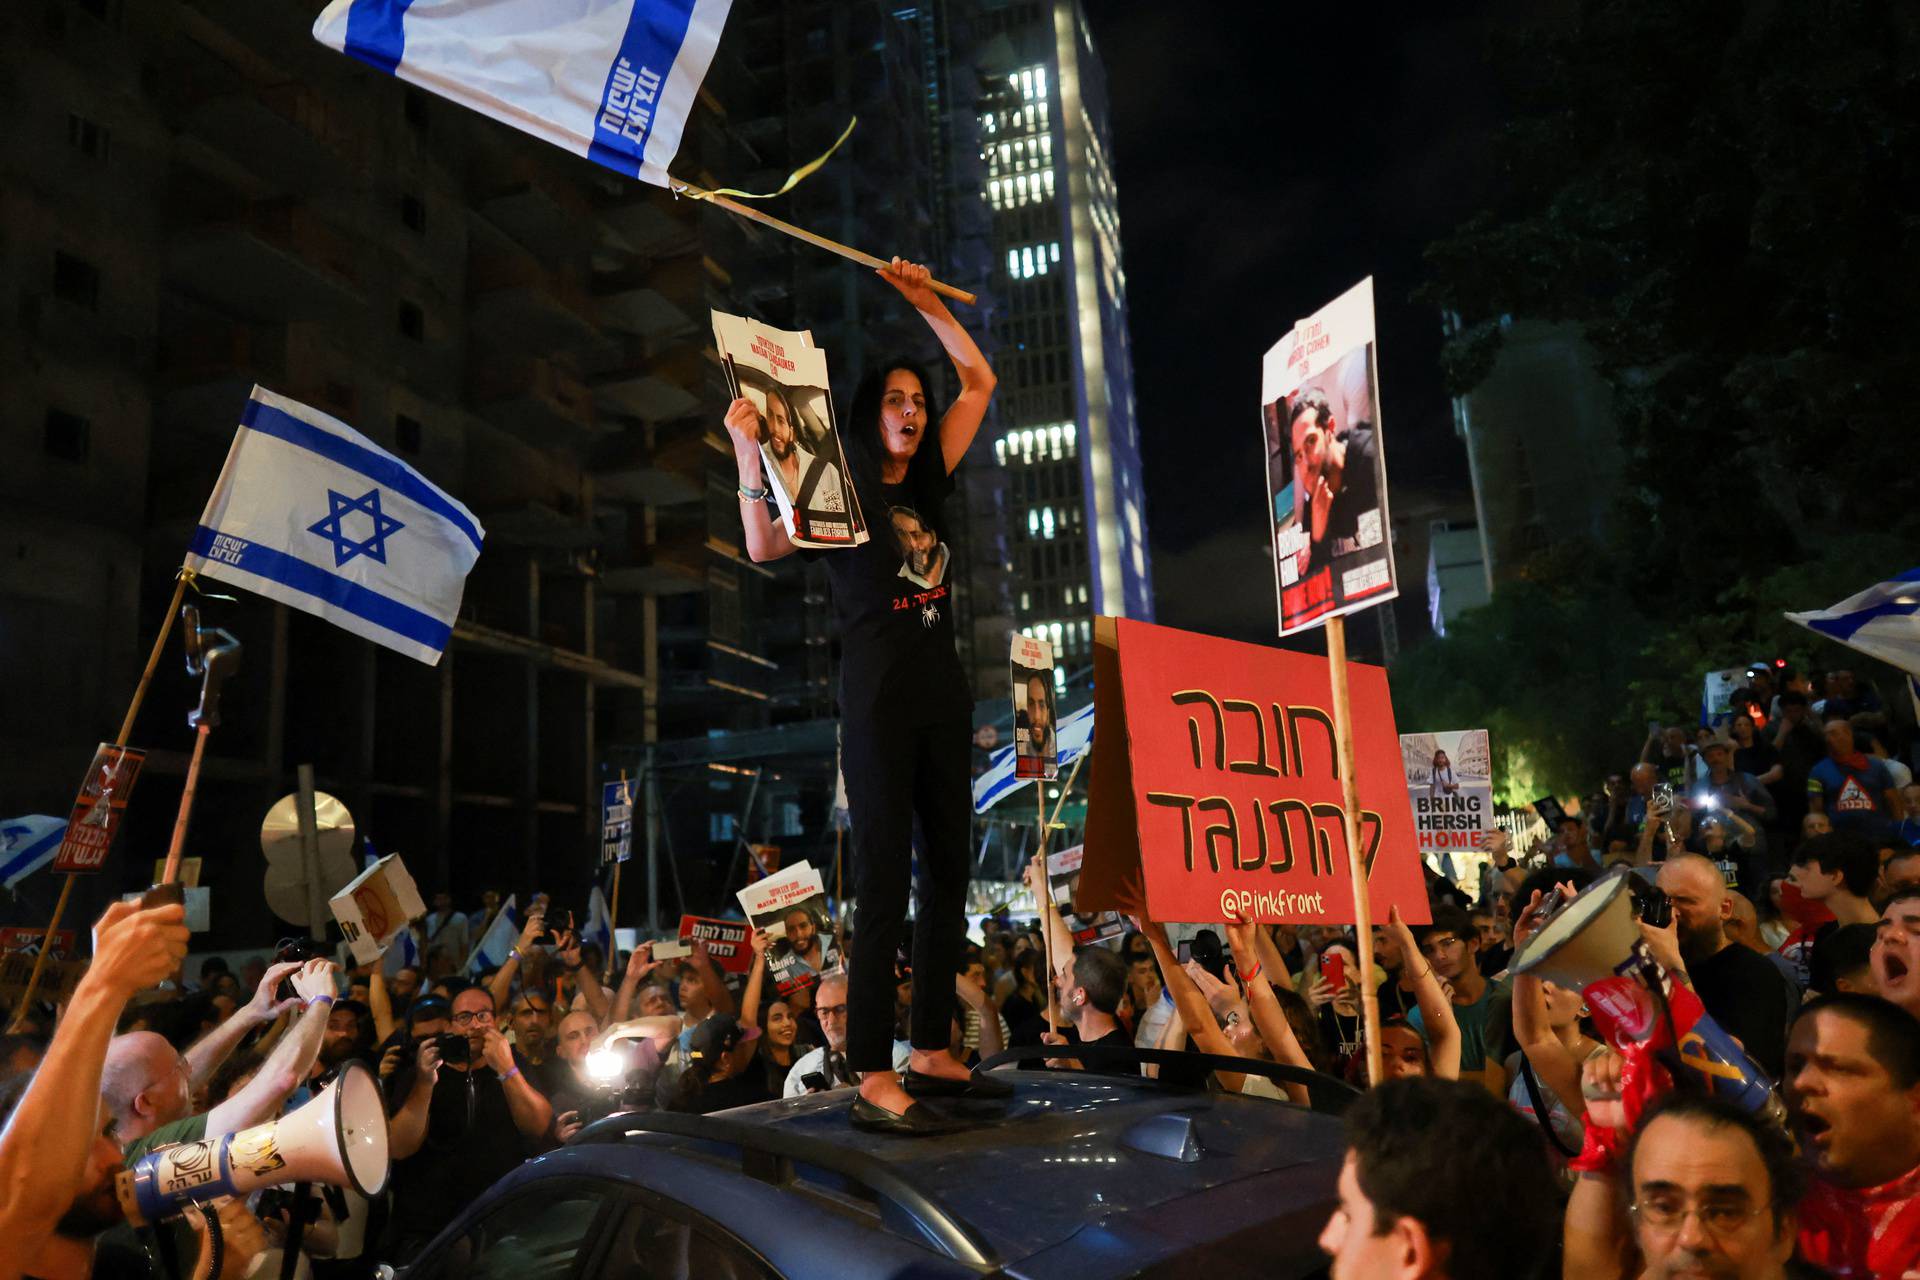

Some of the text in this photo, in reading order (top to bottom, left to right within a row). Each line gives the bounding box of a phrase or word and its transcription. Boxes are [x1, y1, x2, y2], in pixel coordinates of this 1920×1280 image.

[1171, 690, 1342, 780] חובה
[1417, 796, 1481, 813] BRING
[1418, 814, 1482, 830] HERSH
[1419, 832, 1483, 848] HOME
